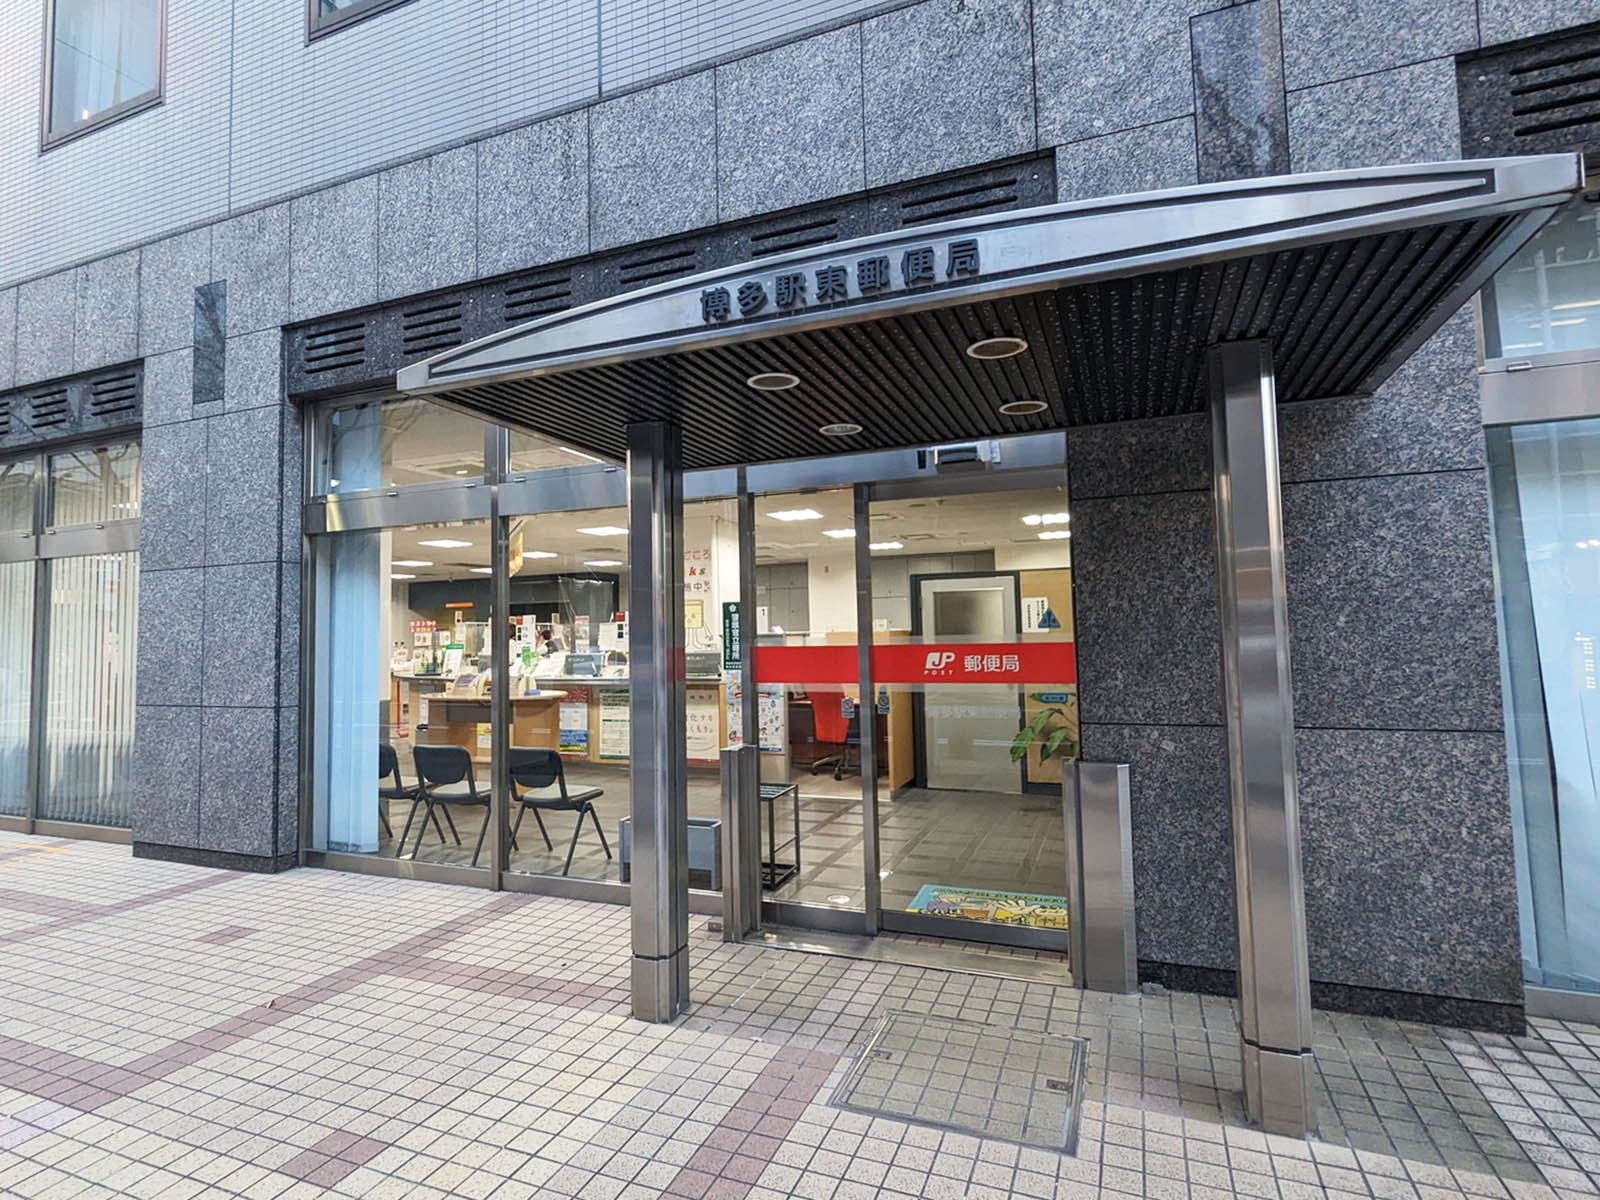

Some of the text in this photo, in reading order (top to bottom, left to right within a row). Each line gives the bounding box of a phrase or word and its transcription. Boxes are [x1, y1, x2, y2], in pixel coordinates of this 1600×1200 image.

[700, 238, 981, 323] 博多駅東郵便局
[925, 652, 955, 669] JP
[964, 655, 1020, 673] 郵便局
